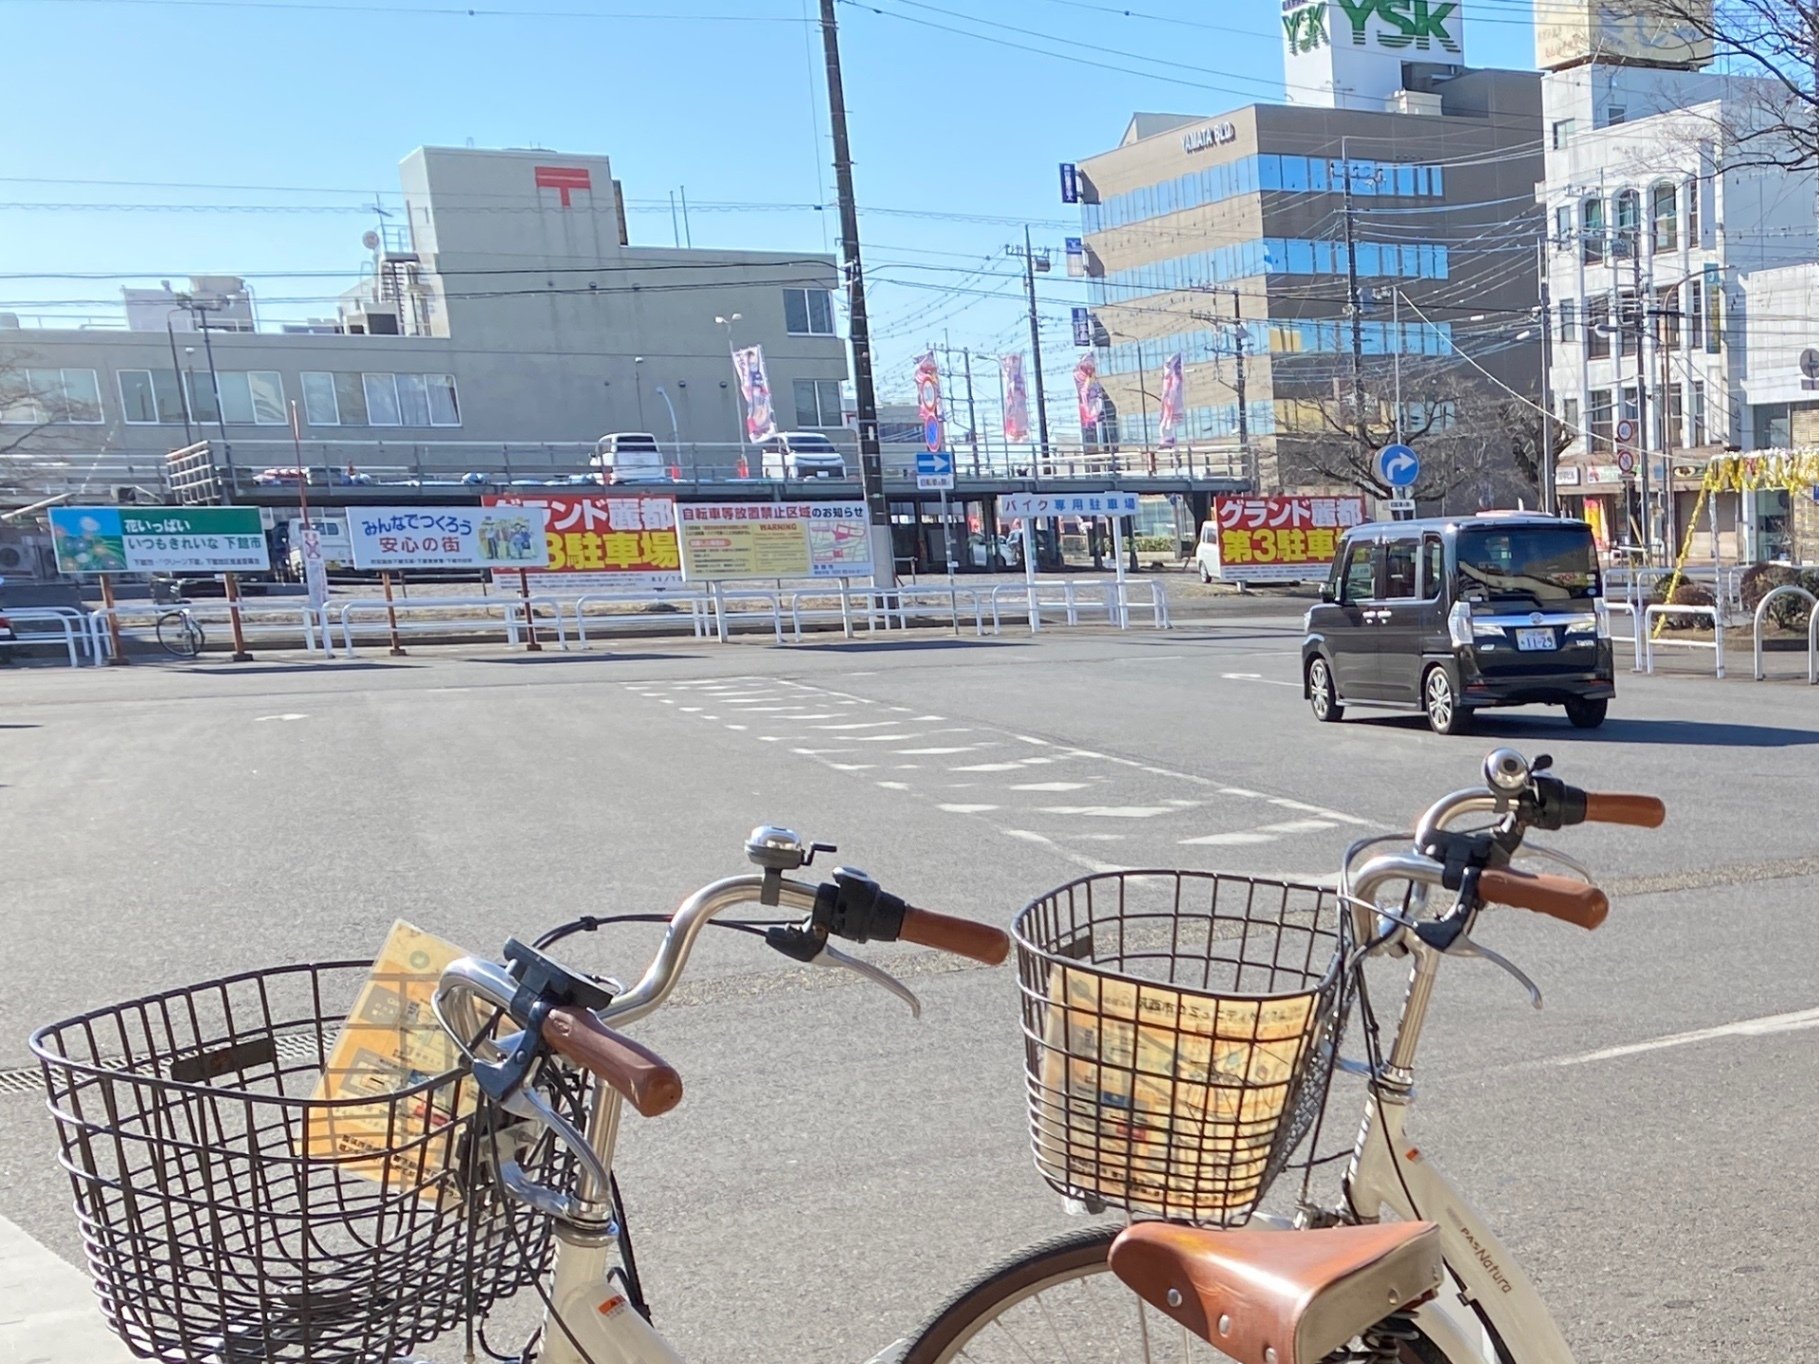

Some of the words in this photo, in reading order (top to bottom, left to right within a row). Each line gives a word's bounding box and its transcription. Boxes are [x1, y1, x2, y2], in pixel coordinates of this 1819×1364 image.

[1337, 0, 1462, 53] YSK
[124, 518, 191, 533] 花いっぱい
[362, 514, 472, 537] みんなでつくろう
[128, 537, 219, 550] いつもきれいな
[379, 537, 461, 553] 安心の街
[1460, 1227, 1480, 1251] PAS
[1475, 1248, 1513, 1294] Natura
